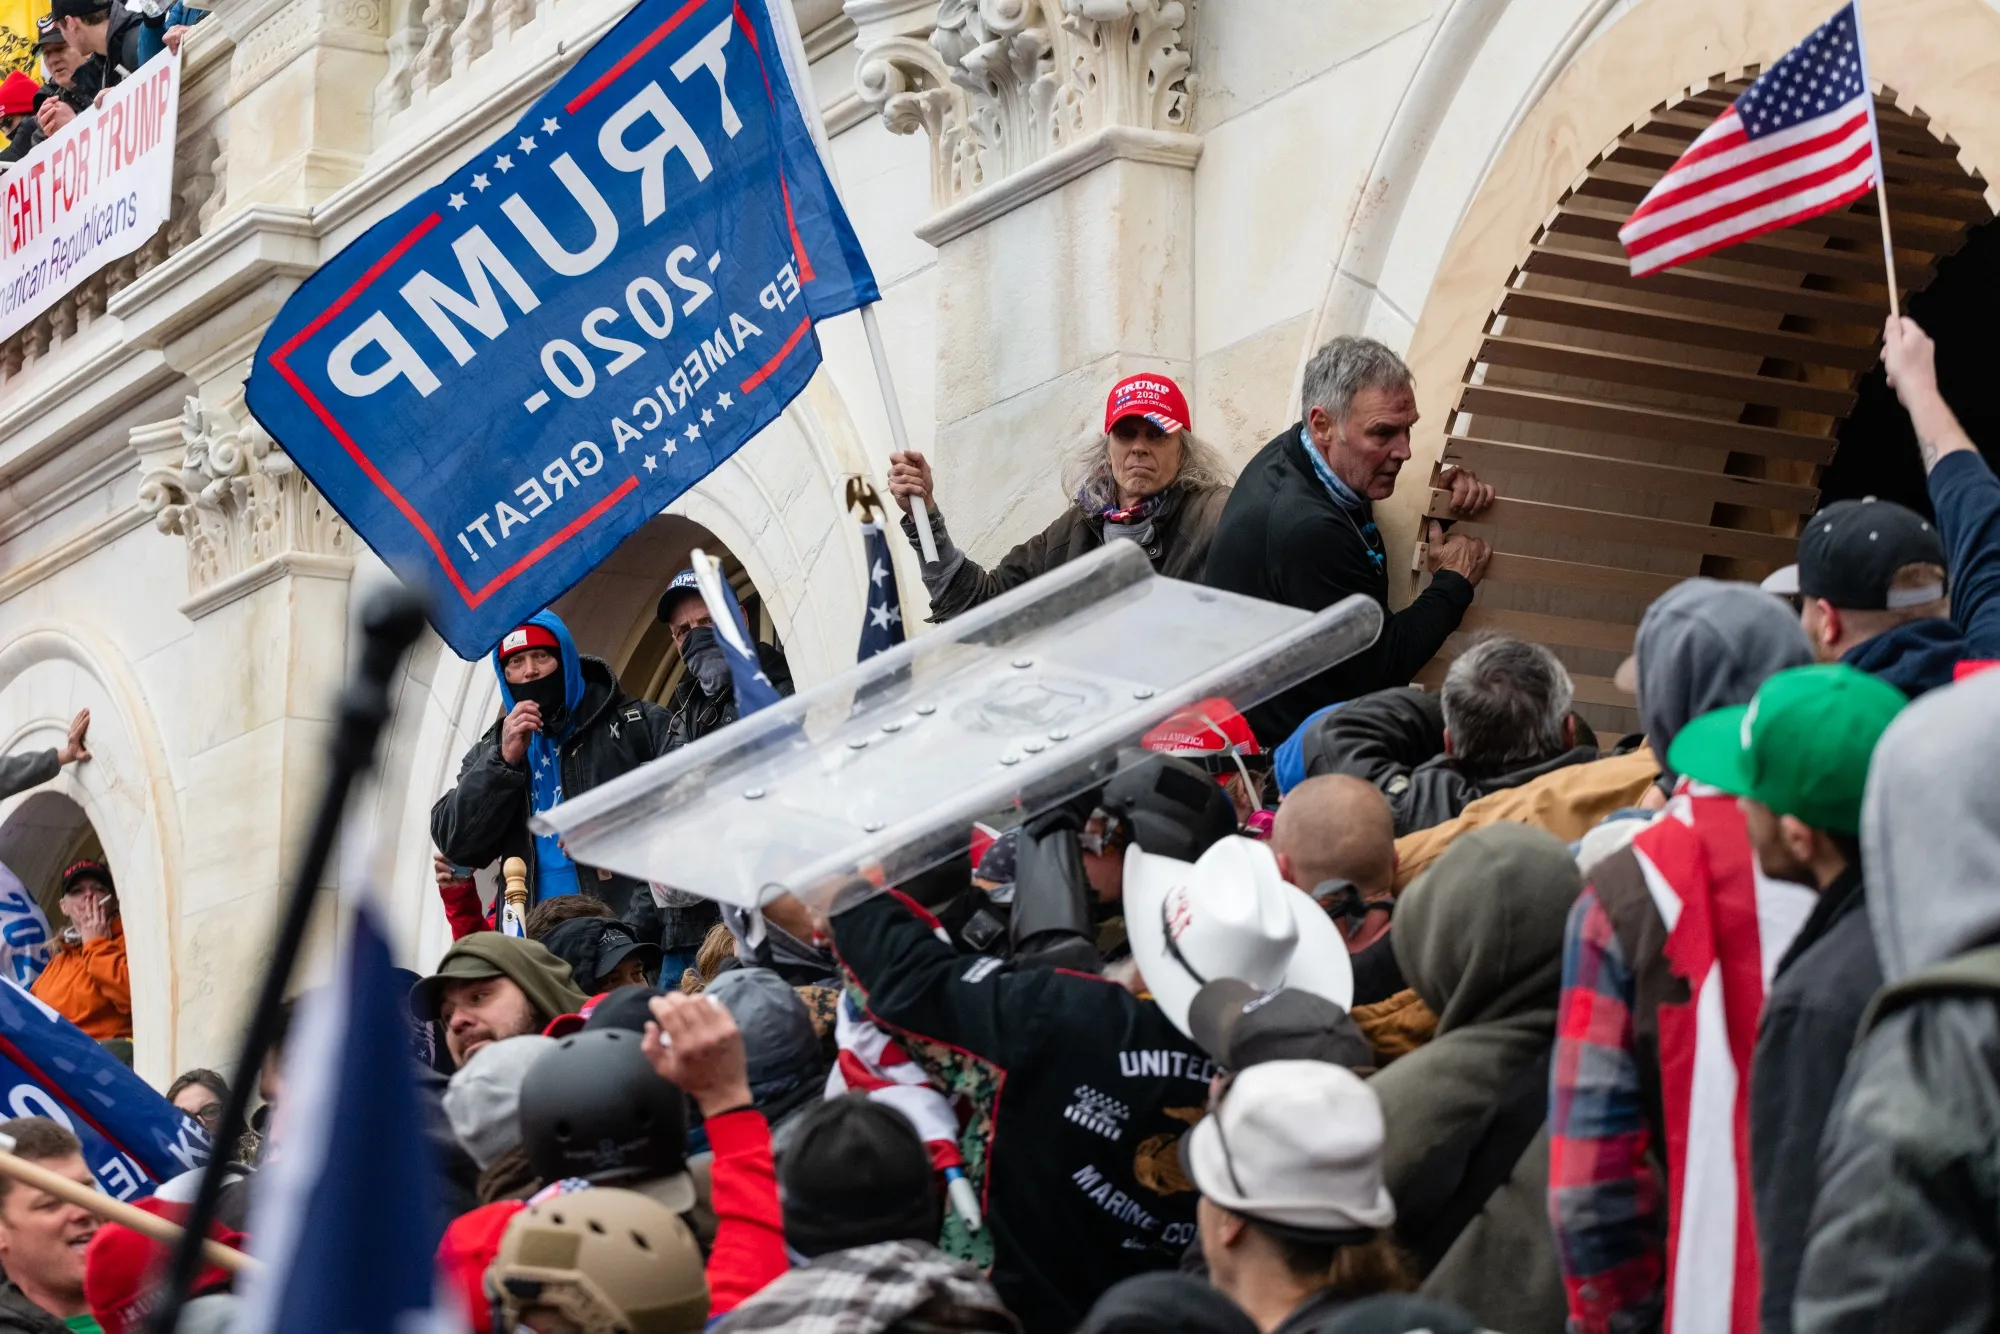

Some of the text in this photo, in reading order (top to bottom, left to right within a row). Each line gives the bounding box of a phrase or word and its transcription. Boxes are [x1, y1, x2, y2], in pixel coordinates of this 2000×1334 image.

[0, 66, 170, 261] IGHT FOR TRUMP
[0, 191, 137, 319] erican Republicans
[1115, 380, 1170, 398] TRUMP
[1136, 391, 1160, 400] 2020
[1071, 1164, 1161, 1231] MARINE
